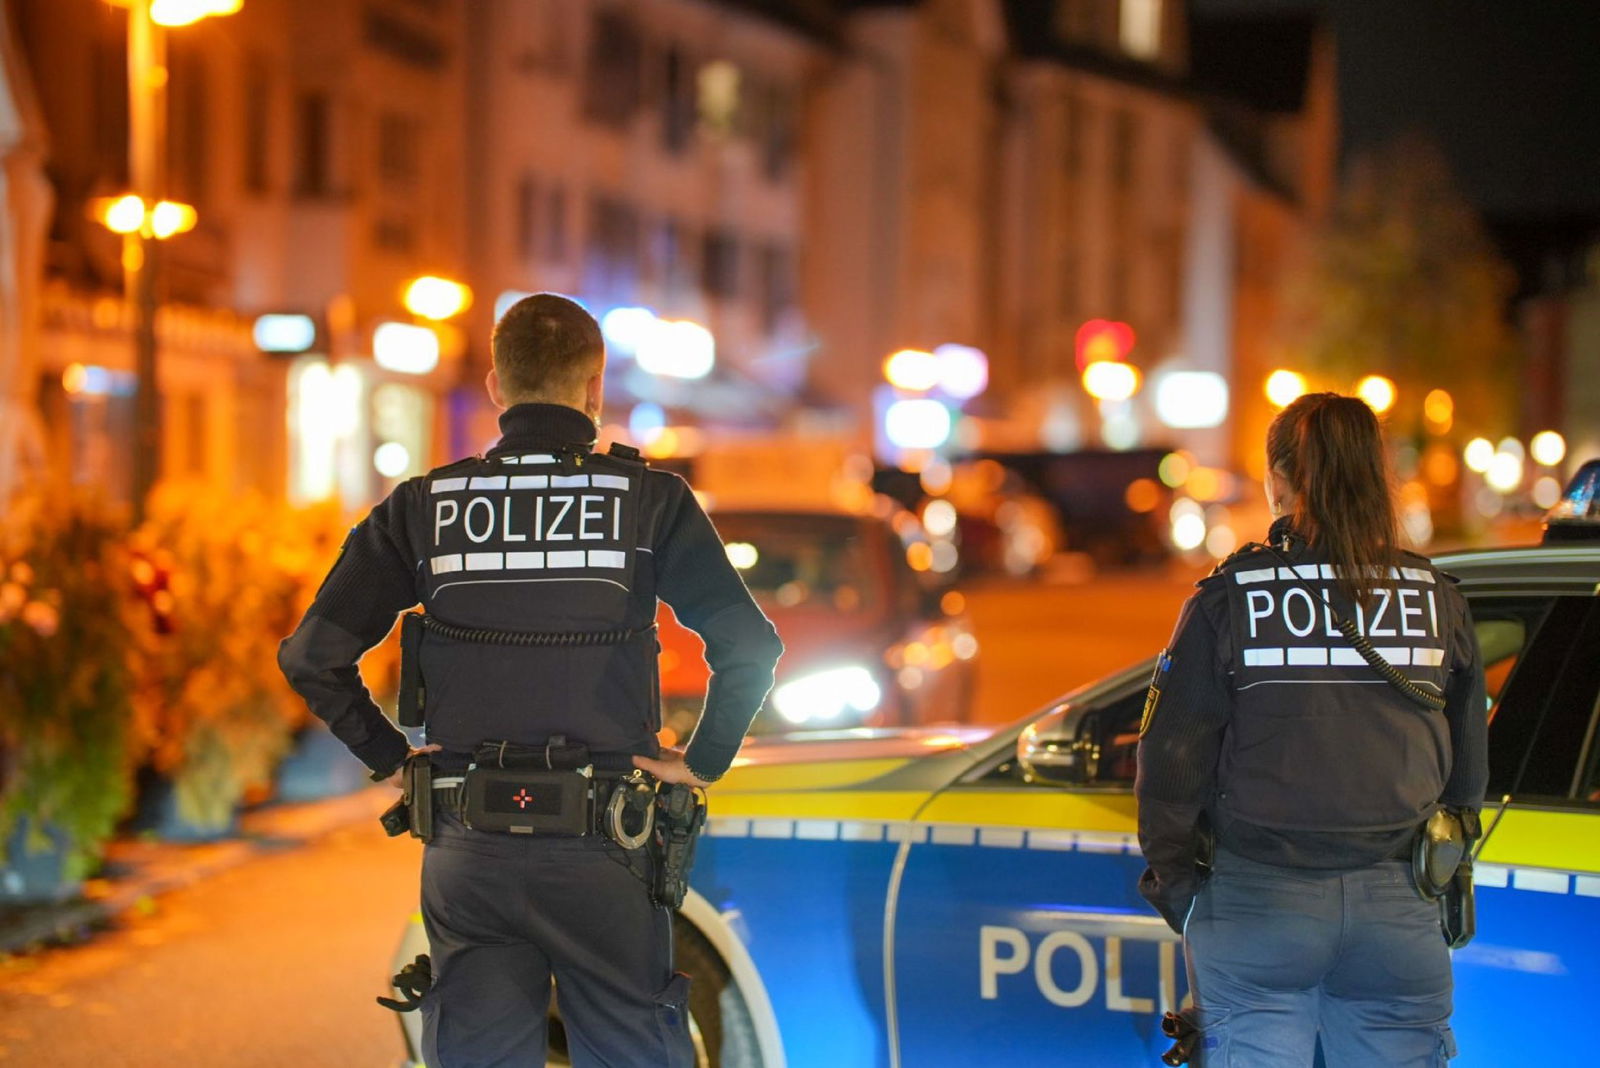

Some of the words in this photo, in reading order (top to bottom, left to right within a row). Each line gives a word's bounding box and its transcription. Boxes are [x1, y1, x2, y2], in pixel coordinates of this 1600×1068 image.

[434, 495, 621, 546] POLIZEI
[1247, 587, 1438, 638] POLIZEI
[980, 925, 1194, 1015] POLI
